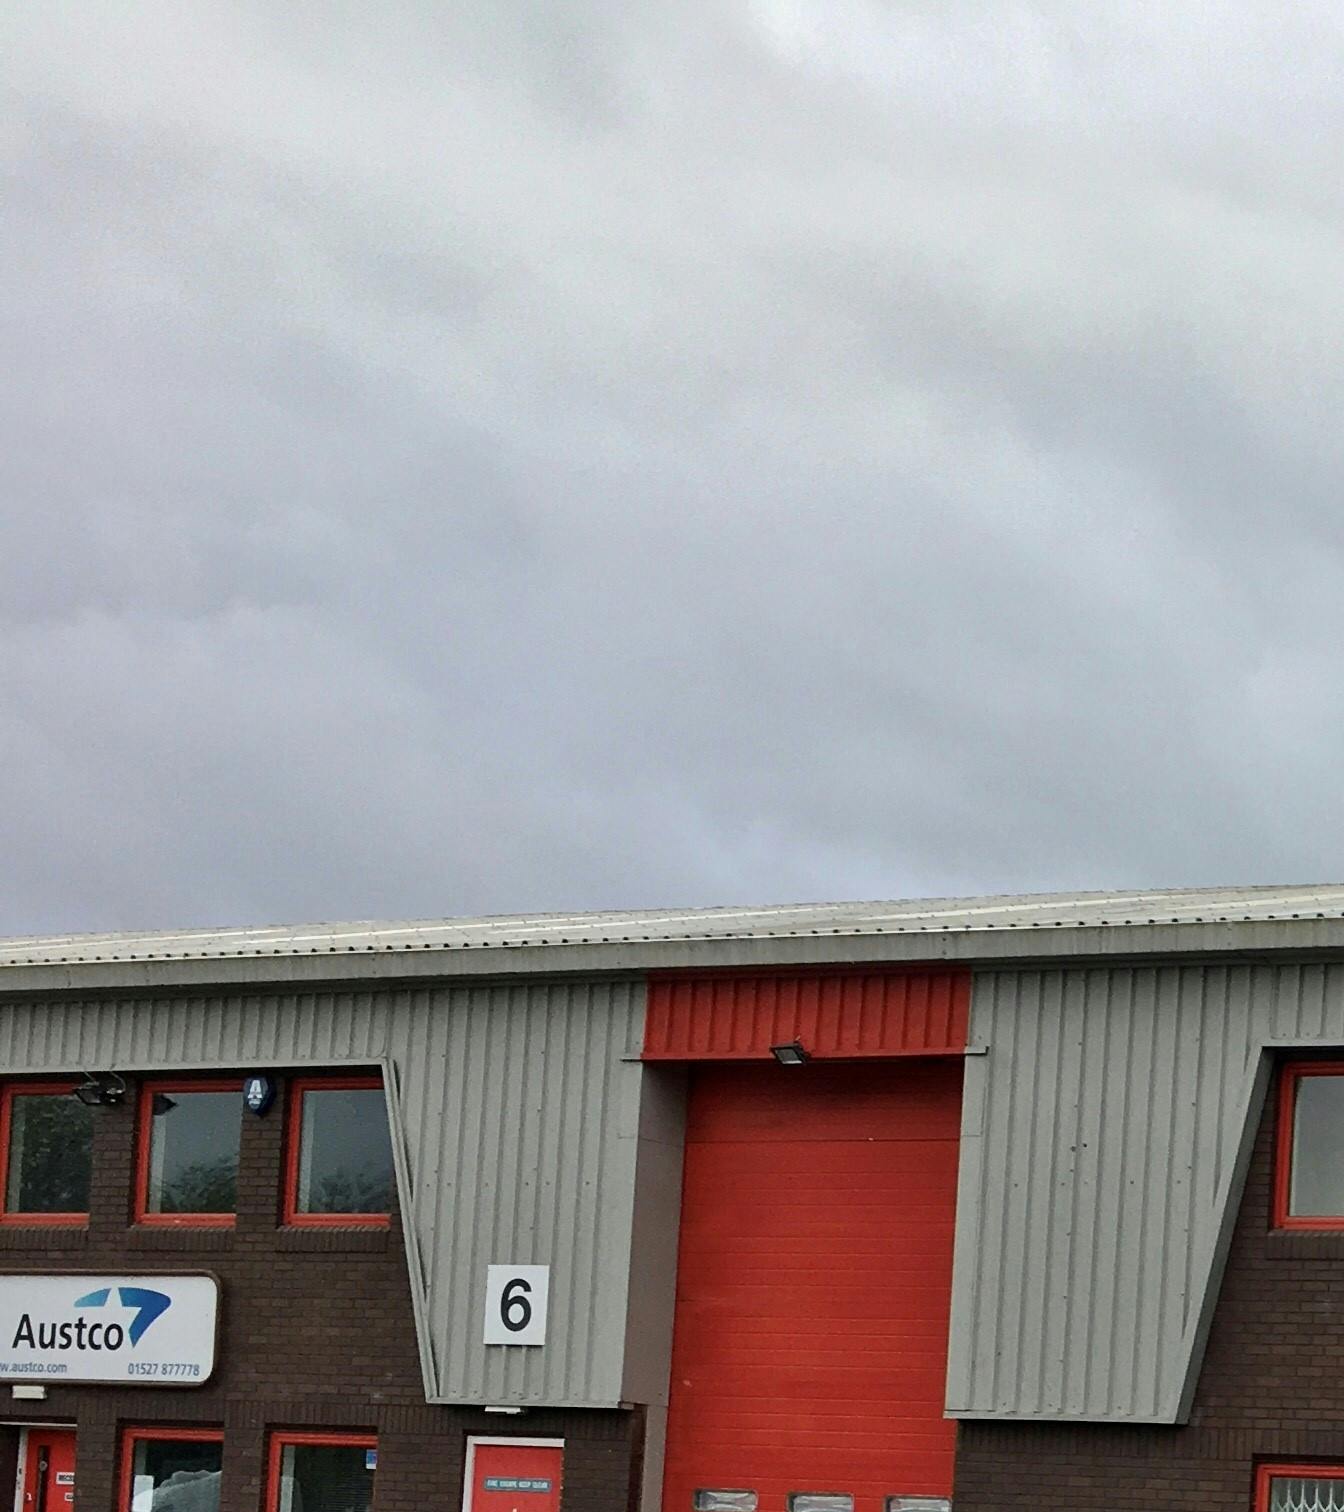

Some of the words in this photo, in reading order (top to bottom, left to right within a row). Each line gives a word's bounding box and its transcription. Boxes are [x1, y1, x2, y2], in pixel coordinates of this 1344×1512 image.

[501, 1278, 532, 1332] 6
[12, 1313, 124, 1350] Austco
[127, 1363, 157, 1376] 01527
[161, 1363, 200, 1377] 877778
